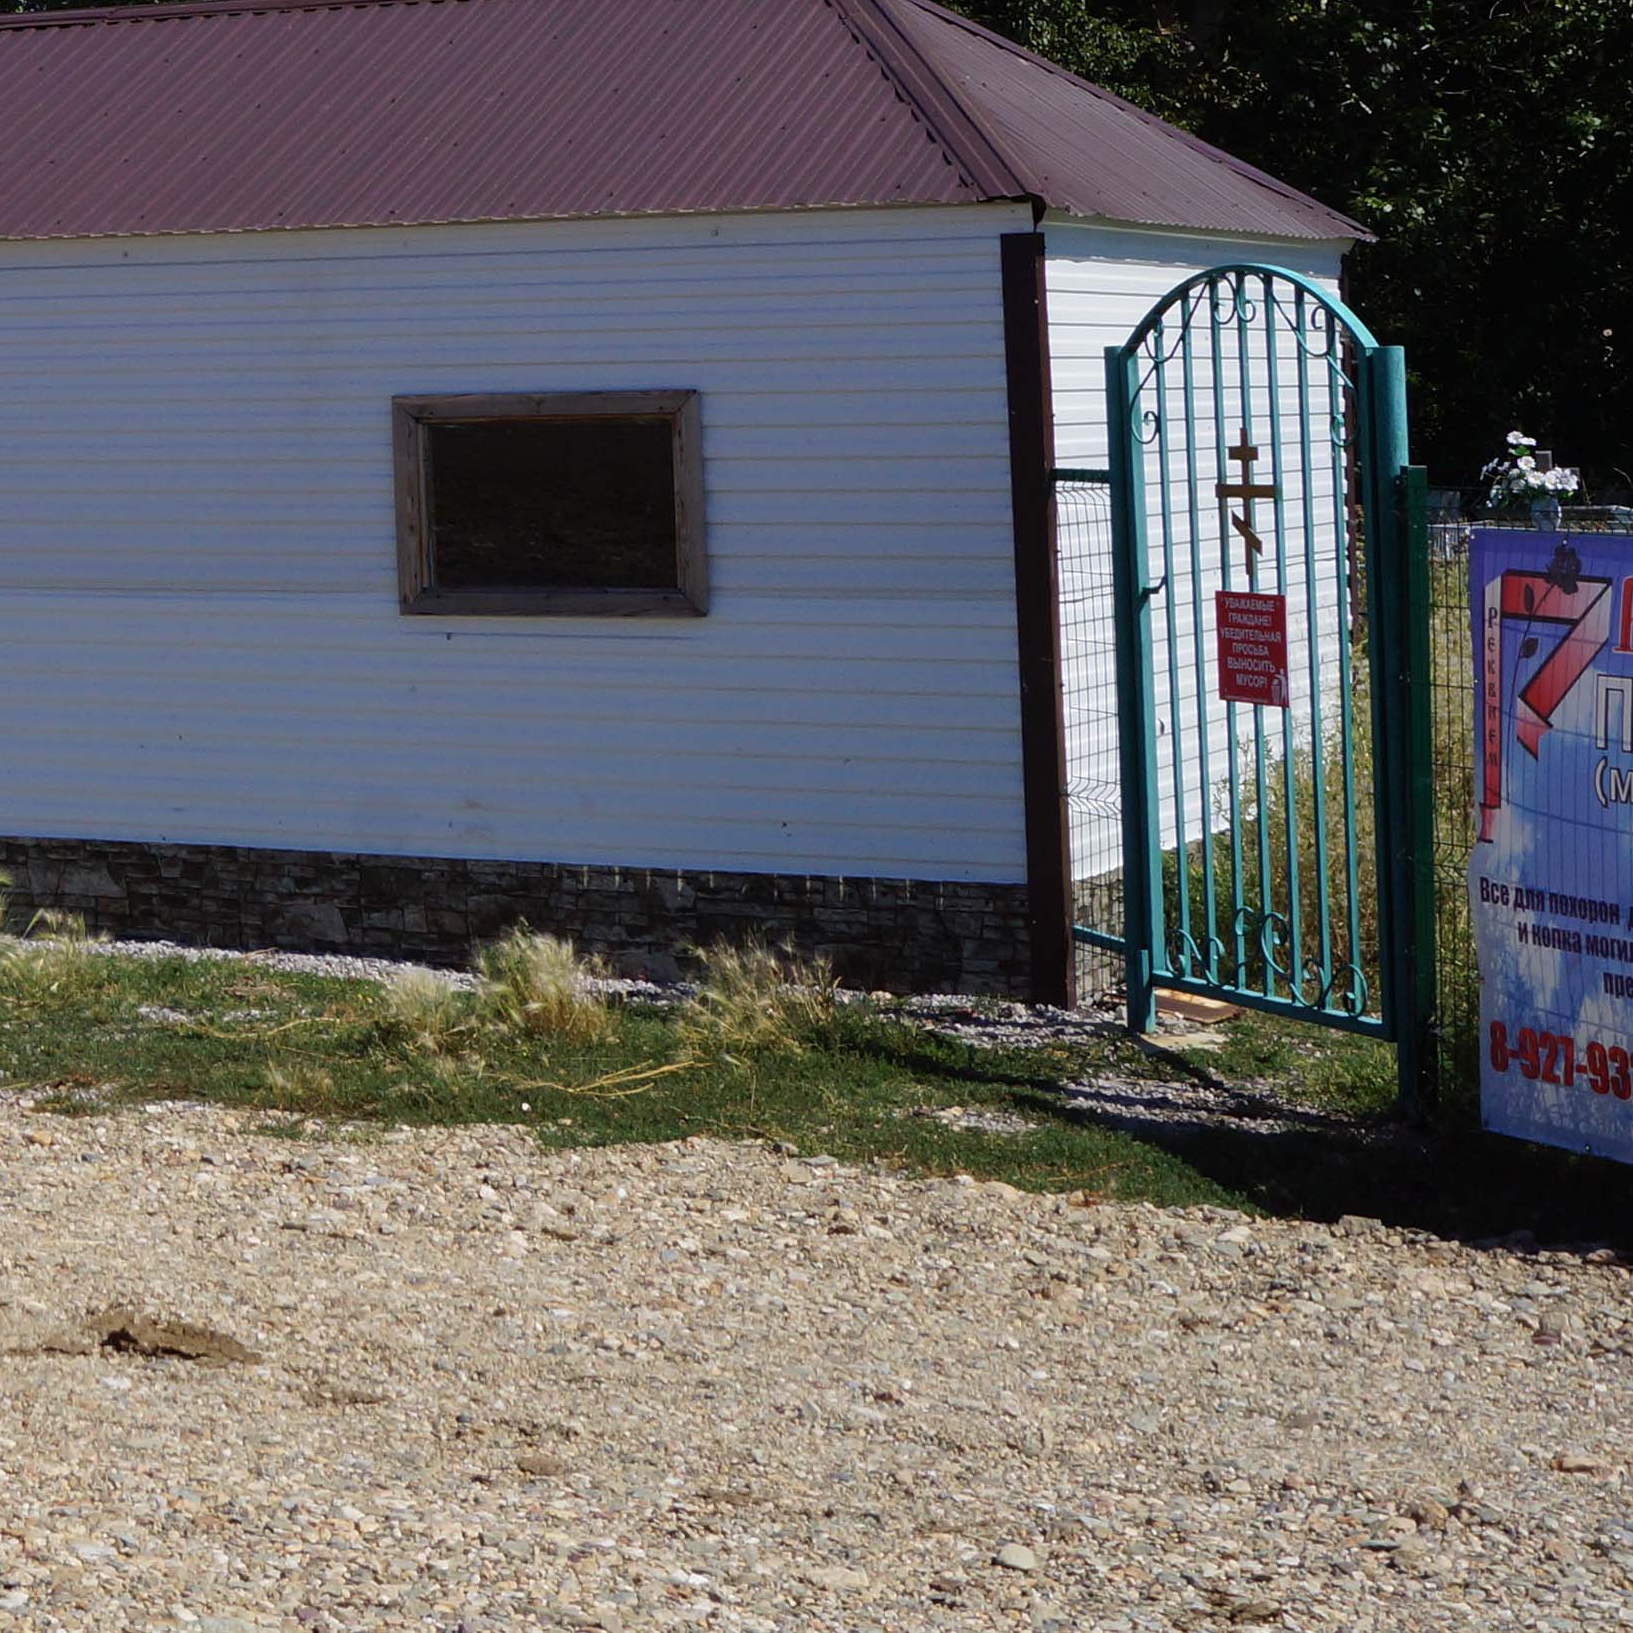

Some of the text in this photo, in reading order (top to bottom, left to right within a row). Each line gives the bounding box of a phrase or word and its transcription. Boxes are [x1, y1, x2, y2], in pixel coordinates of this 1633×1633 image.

[1224, 597, 1275, 612] УВАЖАЕМЫЕ
[1228, 612, 1272, 626] ГРАЖДАНЕ!
[1220, 627, 1282, 643] УБЕДИТЕЛЬНАЯ
[1232, 642, 1270, 656] ПРОСЬБА
[1227, 656, 1276, 673] ВЫНОСИТЬ
[1479, 876, 1510, 906] Все
[1513, 886, 1545, 913] для
[1548, 892, 1620, 926] похорон
[1517, 921, 1529, 945] и
[1531, 923, 1582, 954] копка
[1489, 1020, 1633, 1101] 8-927-93
